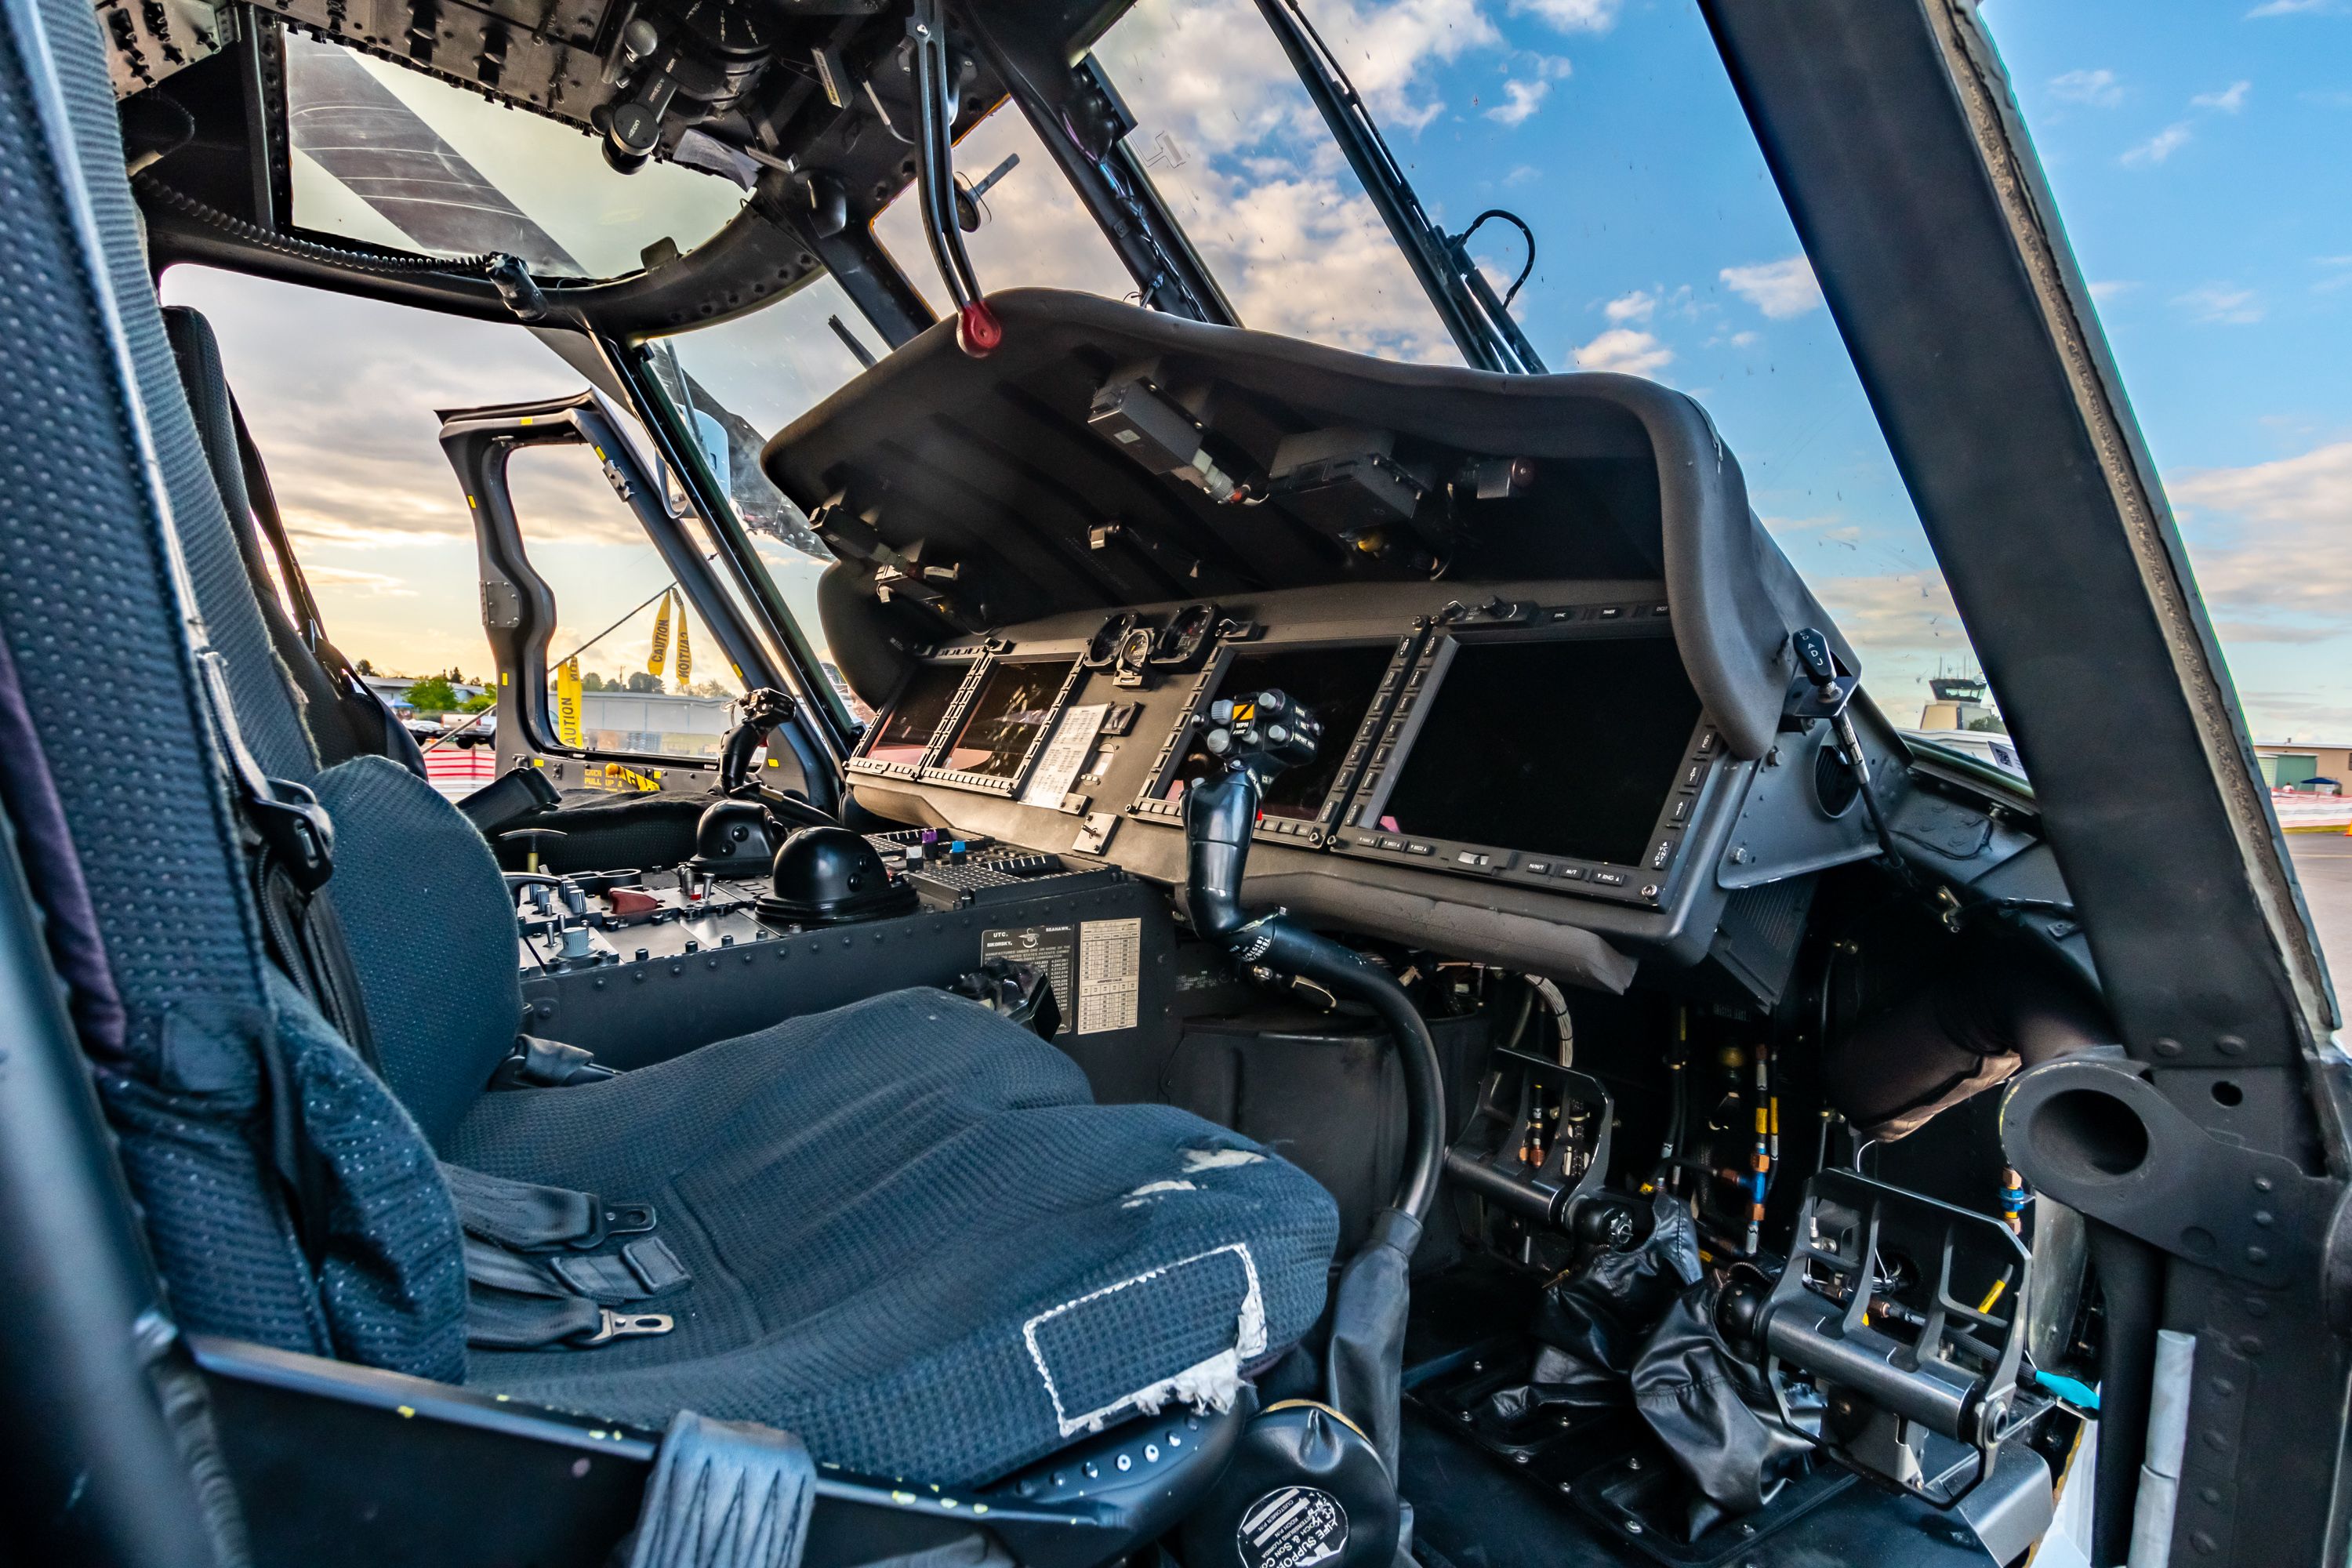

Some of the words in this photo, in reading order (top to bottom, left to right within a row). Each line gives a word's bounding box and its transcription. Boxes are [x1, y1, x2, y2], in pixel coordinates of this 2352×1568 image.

[652, 619, 669, 662] CAUTION
[1808, 643, 1824, 666] ADJ
[561, 697, 577, 745] AUTION
[1266, 1499, 1294, 1524] CUSTOMER
[1283, 1516, 1298, 1530] KOCH
[1282, 1514, 1313, 1541] ETERSBURG
[1315, 1519, 1338, 1540] LIFE
[1261, 1539, 1283, 1559] FLORIDA
[1291, 1535, 1301, 1544] &
